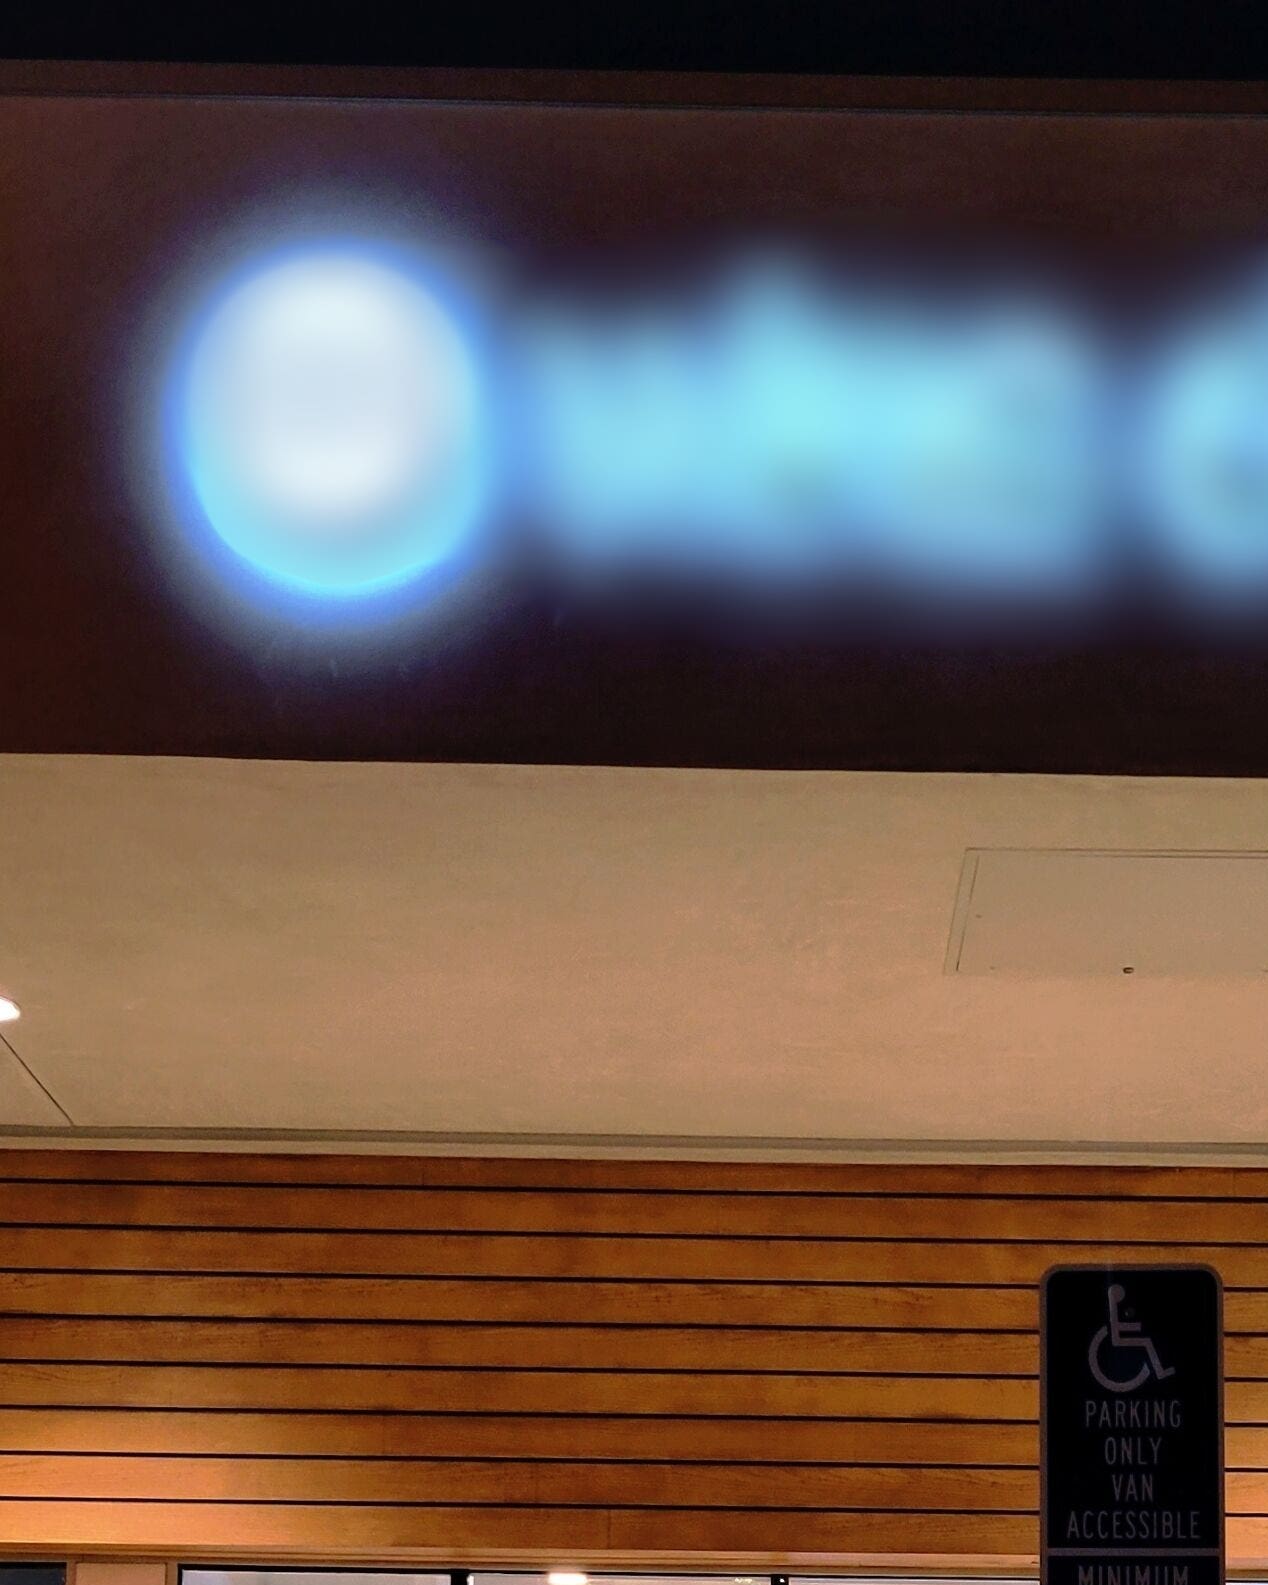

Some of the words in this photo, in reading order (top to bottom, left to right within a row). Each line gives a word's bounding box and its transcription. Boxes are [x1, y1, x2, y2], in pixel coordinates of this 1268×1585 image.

[1085, 1400, 1181, 1428] PARKING
[1104, 1437, 1162, 1465] ONLY
[1112, 1474, 1154, 1501] VAN
[1067, 1511, 1200, 1539] ACCESSIBLE
